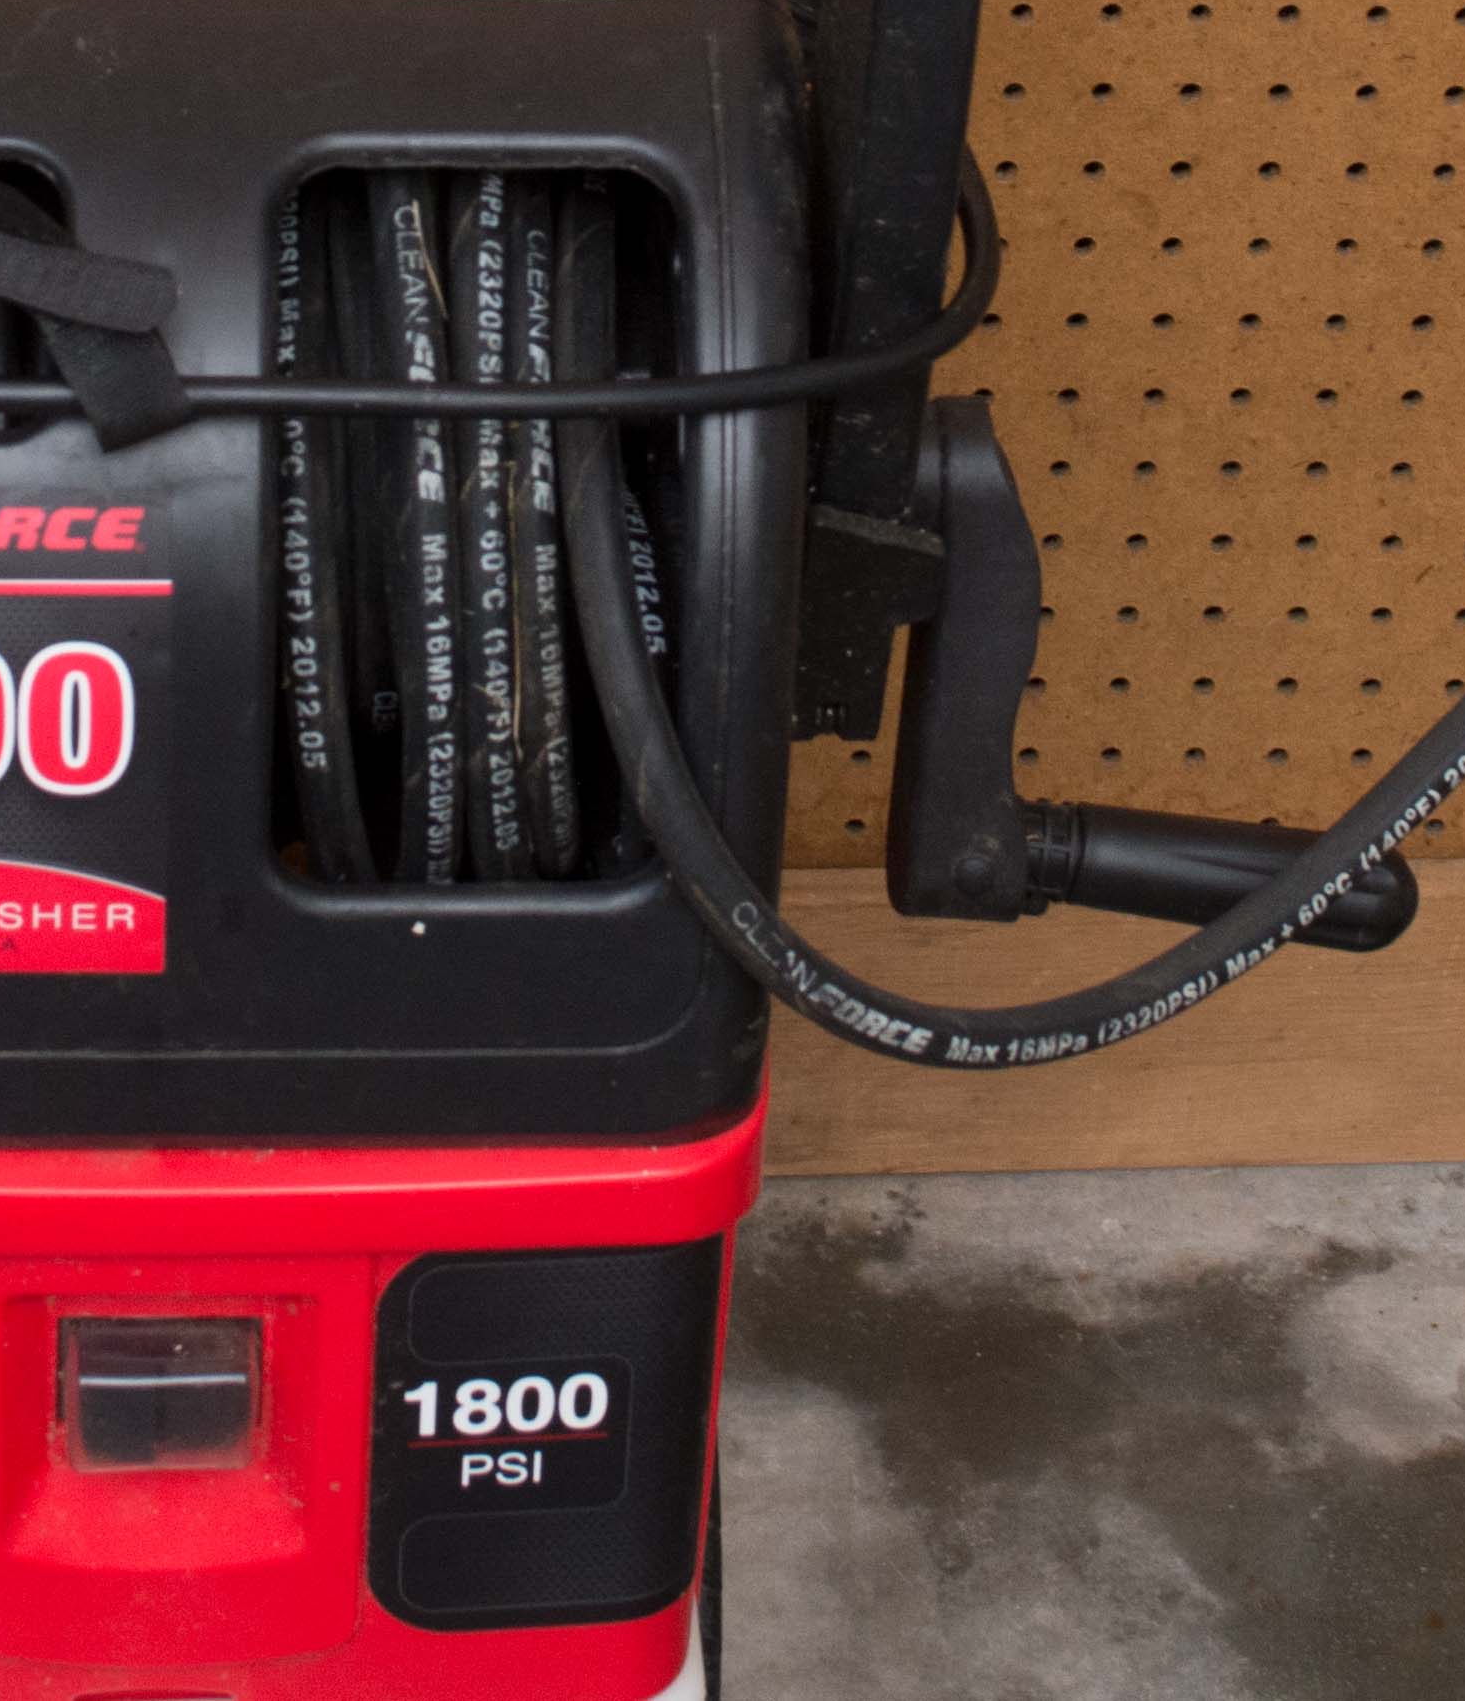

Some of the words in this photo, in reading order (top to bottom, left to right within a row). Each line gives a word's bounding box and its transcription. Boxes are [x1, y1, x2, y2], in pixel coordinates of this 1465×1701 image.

[278, 192, 300, 287] 20PSI)
[278, 298, 299, 364] Max
[478, 240, 504, 384] (2320PSI
[281, 416, 306, 479] 0°C
[422, 534, 448, 603] Max
[479, 528, 507, 610] 60°C
[535, 544, 558, 616] Max
[629, 539, 667, 655] 2012.05
[290, 636, 327, 770] 2012.05
[424, 616, 454, 721] 16MPa
[945, 1034, 1001, 1066] Max
[1097, 972, 1222, 1048] (2320PSI)
[1224, 938, 1278, 981] Max
[1357, 787, 1444, 874] (140°F)
[403, 1372, 609, 1437] 1800
[461, 1450, 543, 1488] PSI
